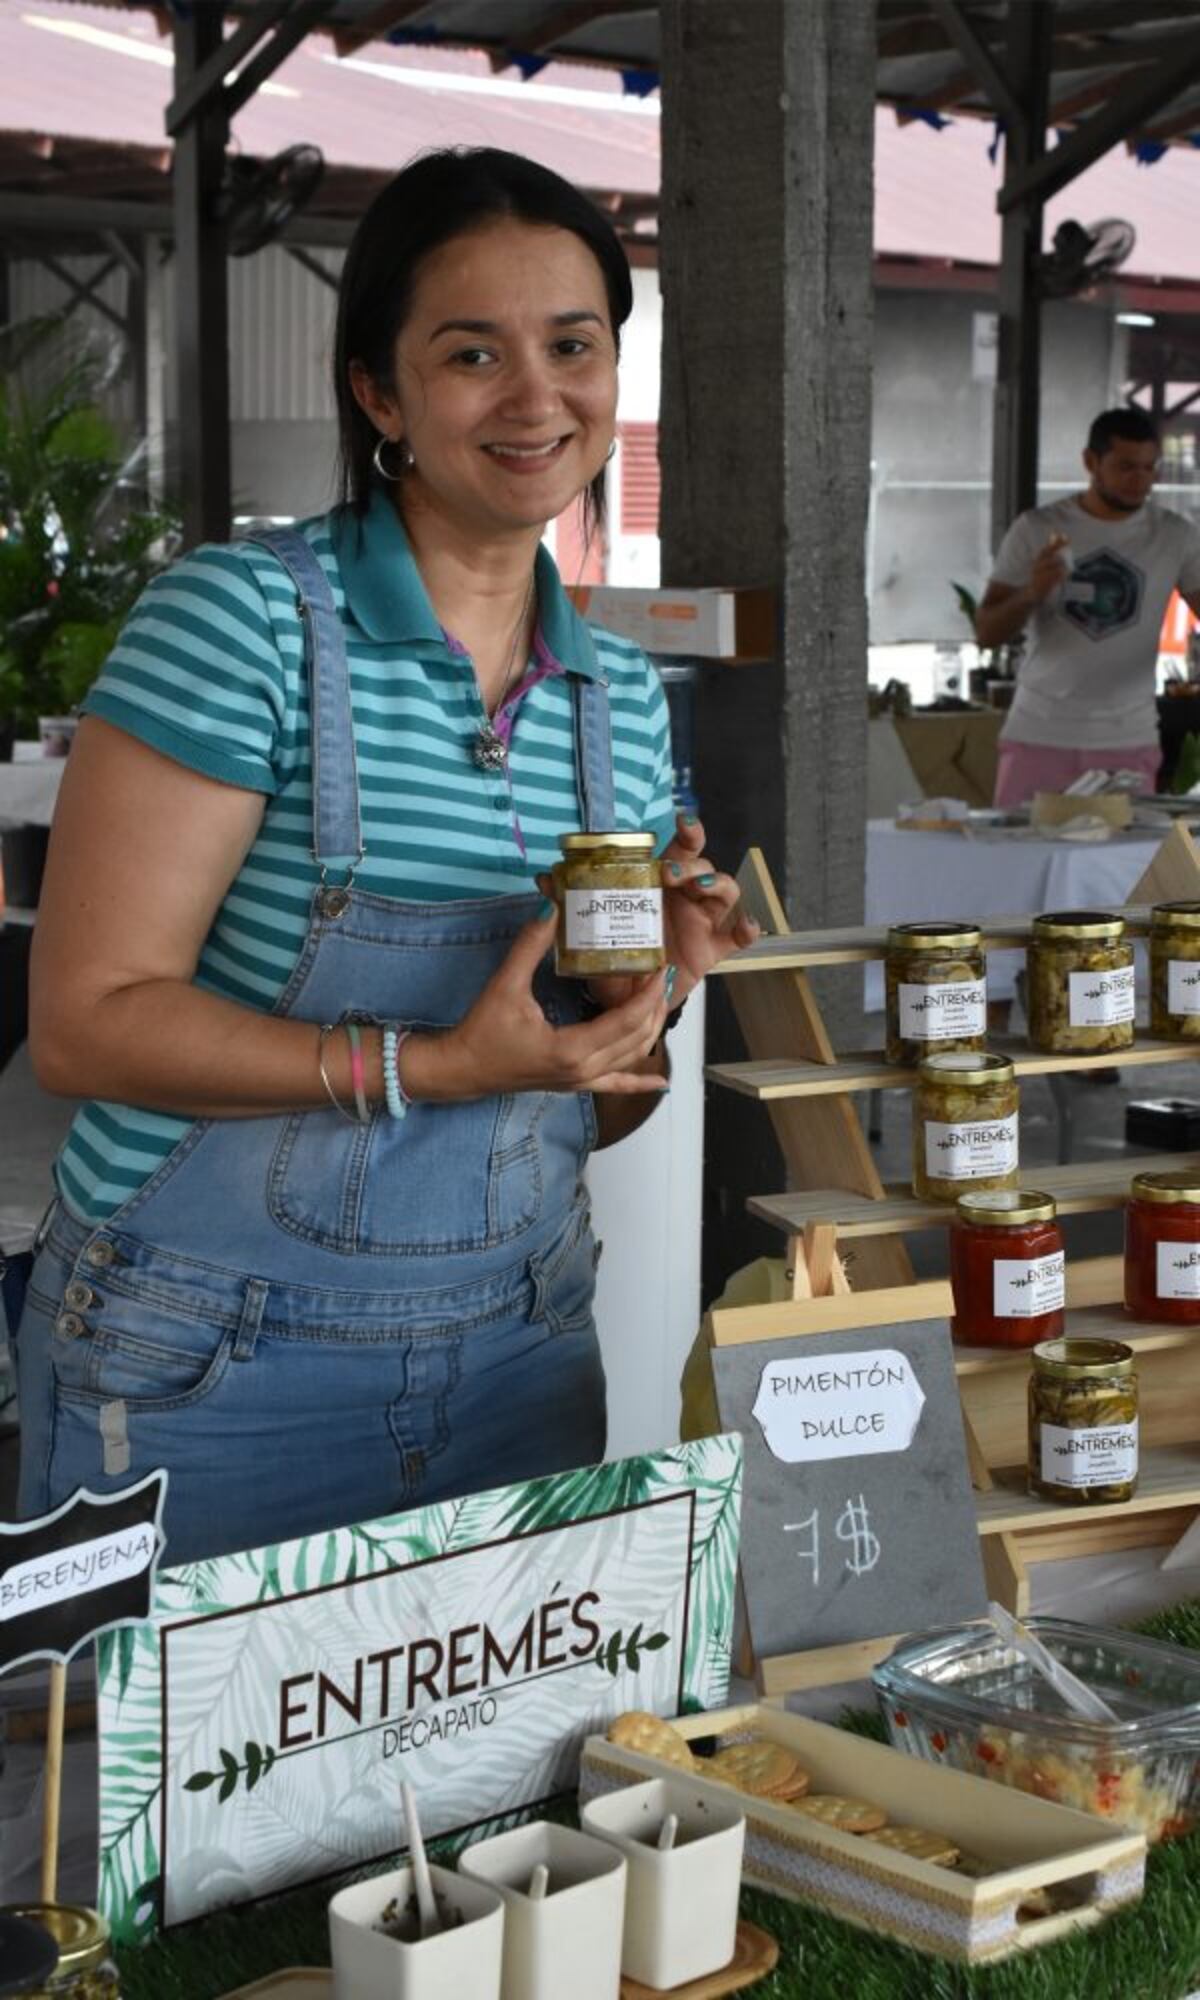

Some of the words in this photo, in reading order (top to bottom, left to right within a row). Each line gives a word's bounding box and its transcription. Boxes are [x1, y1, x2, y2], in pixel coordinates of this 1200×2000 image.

[770, 1361, 906, 1396] PIMENTÓN
[801, 1412, 886, 1440] DULCE
[0, 1535, 150, 1607] BERENJENA
[279, 1581, 602, 1748] ENTREMÉS
[381, 1697, 497, 1760] DECAPATO
